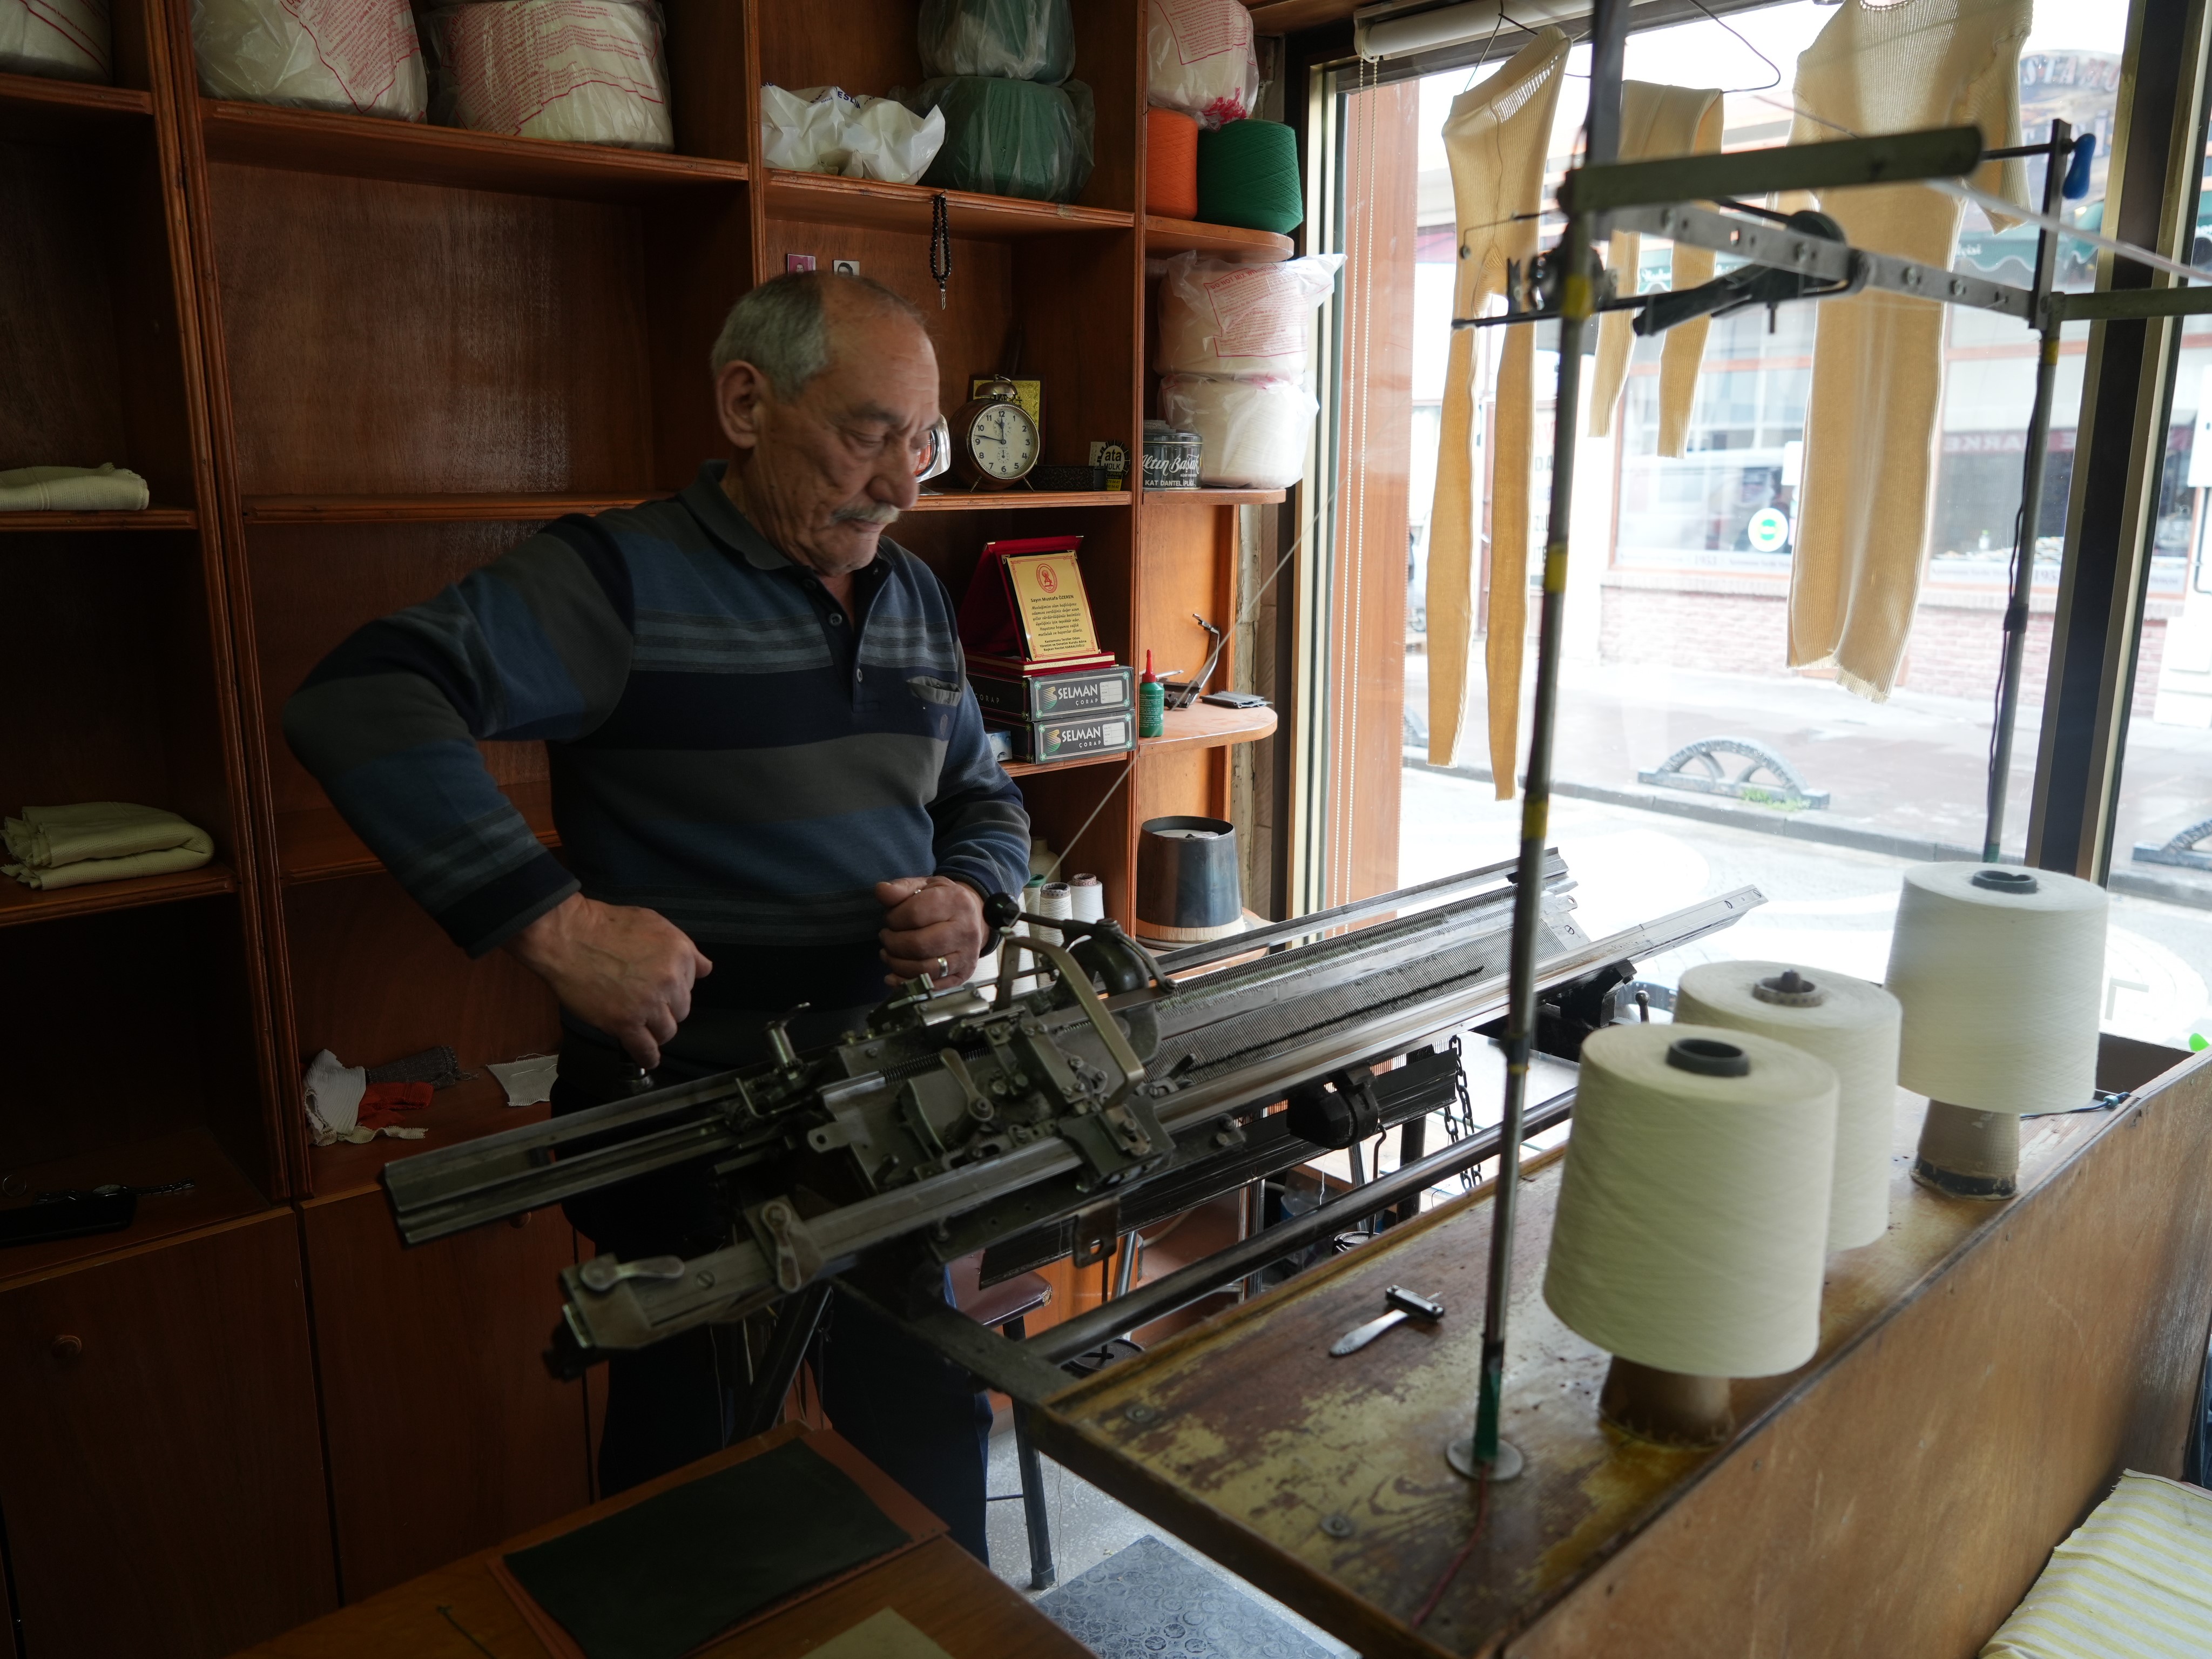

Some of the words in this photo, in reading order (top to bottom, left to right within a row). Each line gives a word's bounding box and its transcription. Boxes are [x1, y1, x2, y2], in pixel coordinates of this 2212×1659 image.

[1105, 449, 1122, 462] ata
[1057, 684, 1098, 700] SELMAN
[1075, 698, 1098, 706] ÇORAP
[1061, 726, 1101, 743] SELMAN
[1079, 740, 1102, 748] ÇORAP
